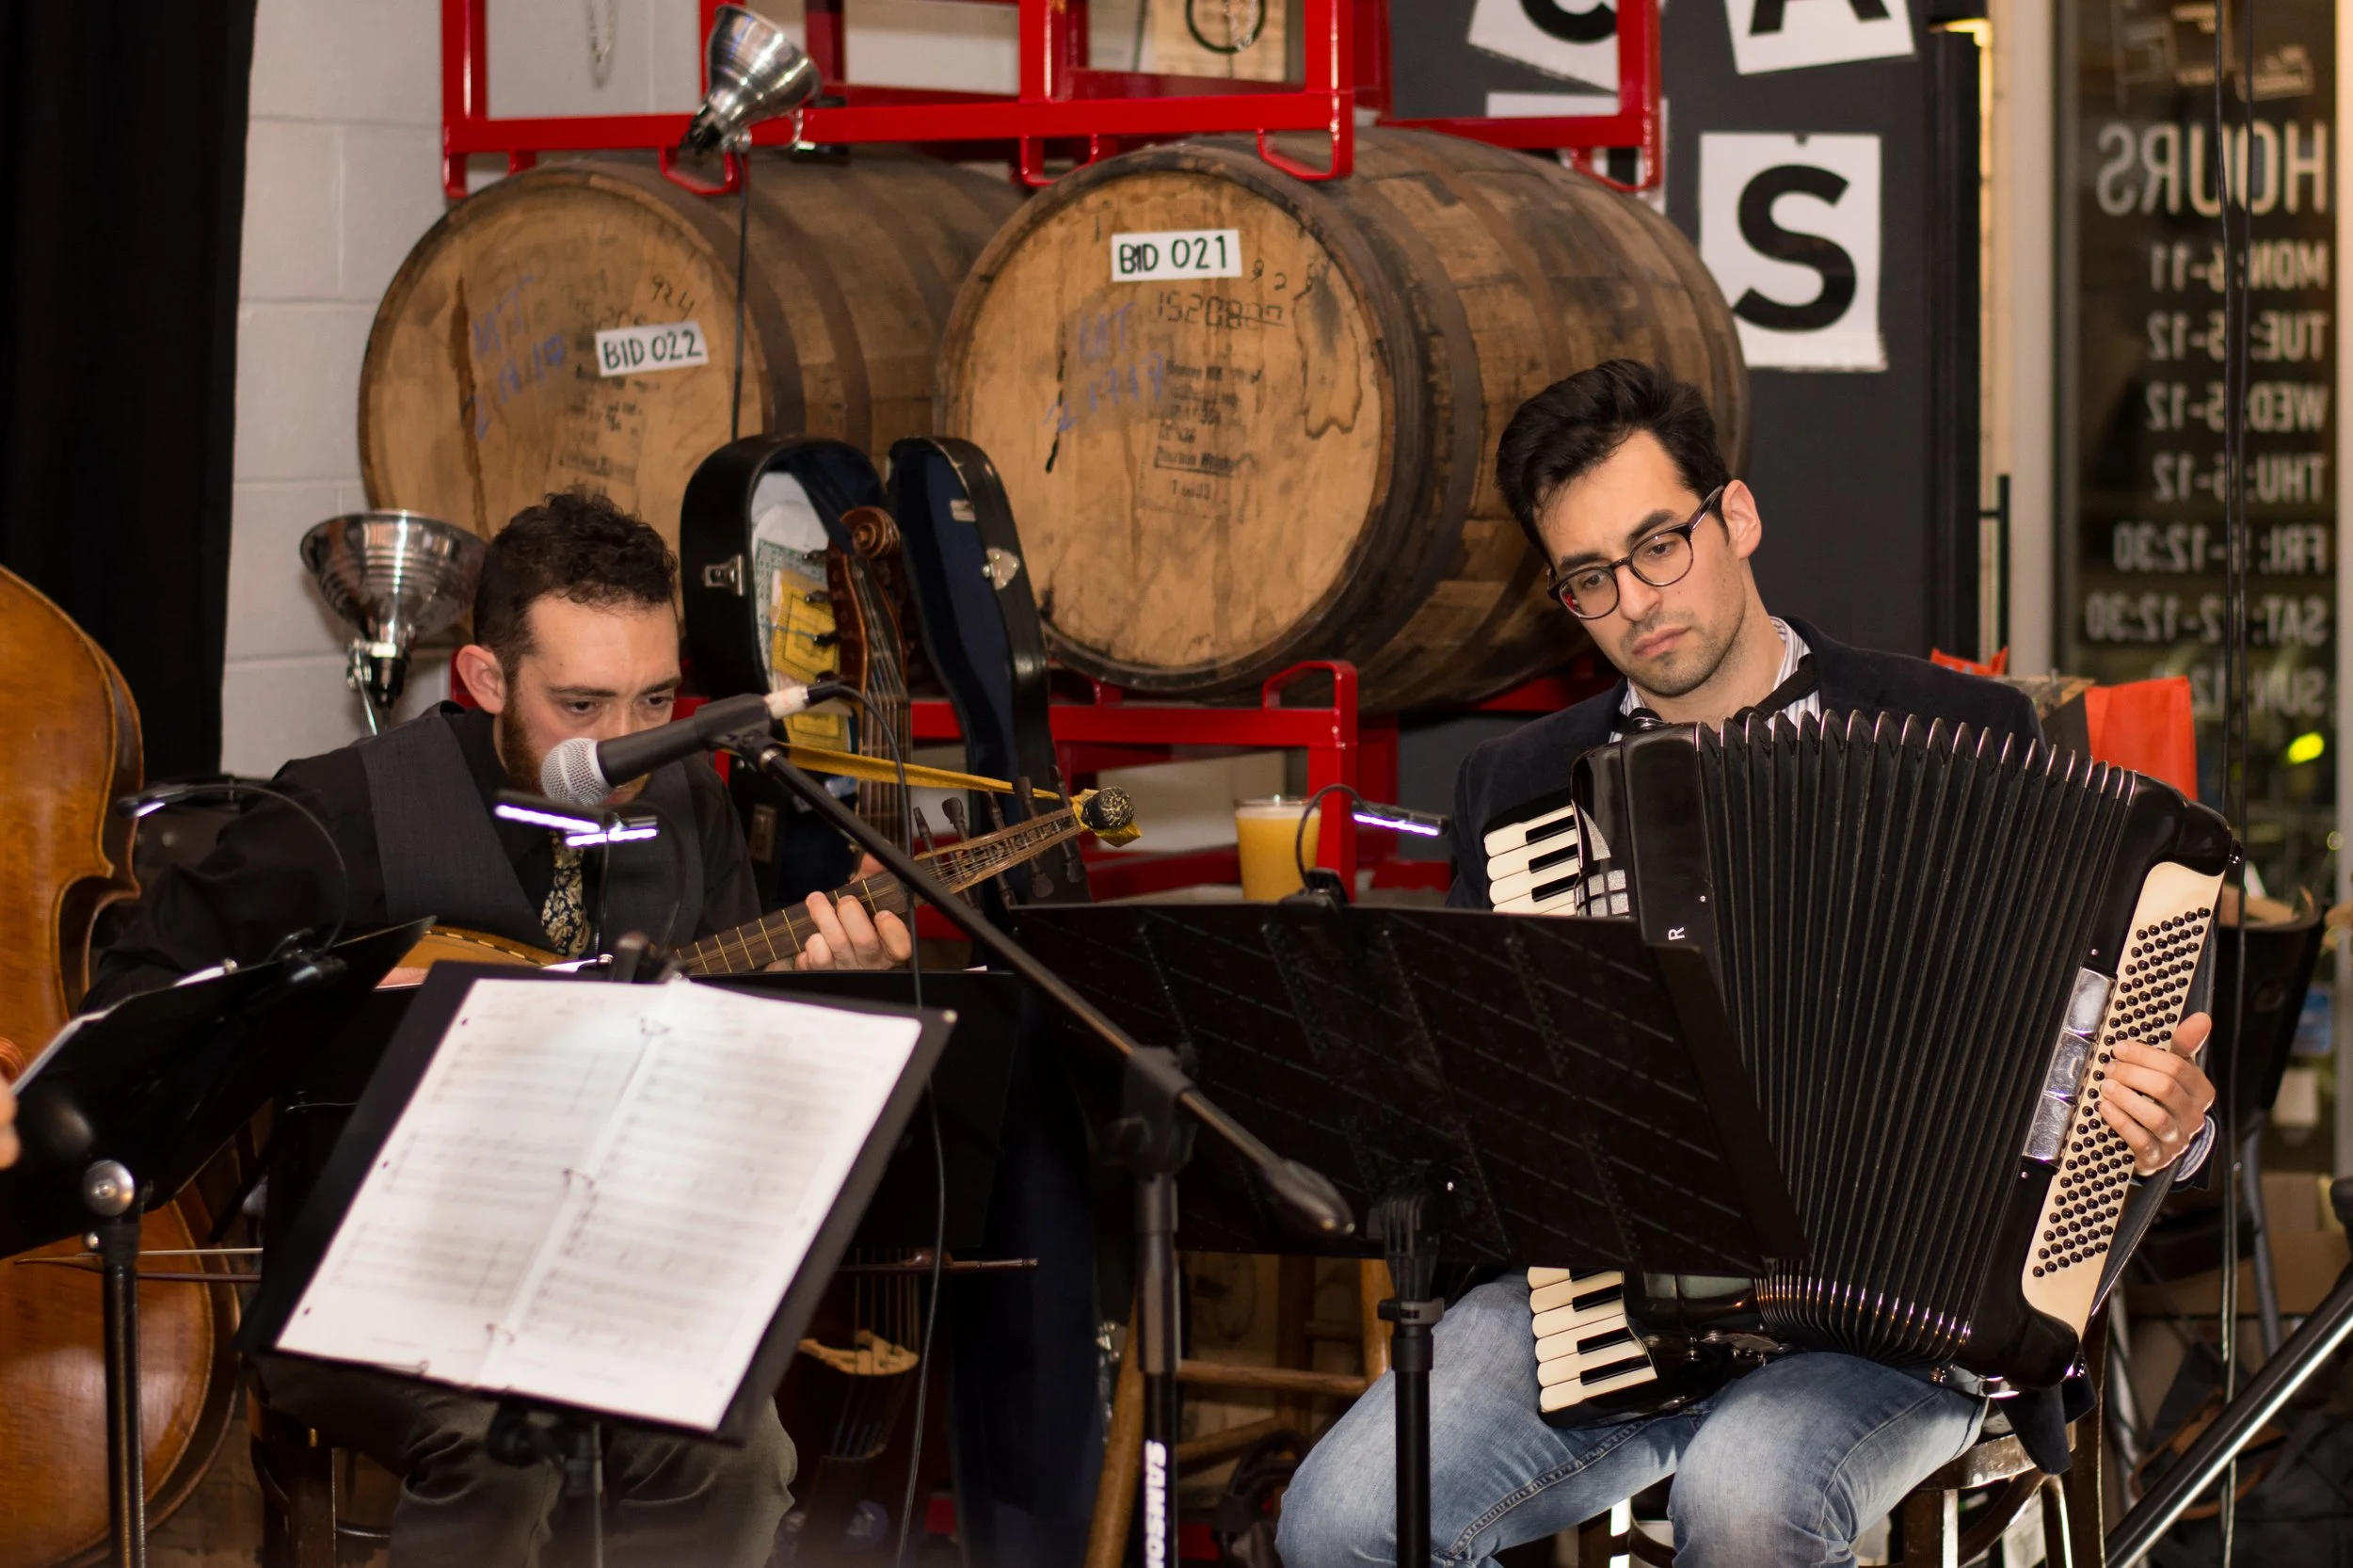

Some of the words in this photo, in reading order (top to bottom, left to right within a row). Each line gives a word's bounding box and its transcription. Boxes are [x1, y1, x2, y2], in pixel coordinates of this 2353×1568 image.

[1118, 243, 1160, 275] BID
[1171, 234, 1227, 270] 021
[1733, 164, 1857, 333] S
[602, 338, 646, 371] BID
[651, 329, 703, 363] 022
[1668, 927, 1685, 940] R
